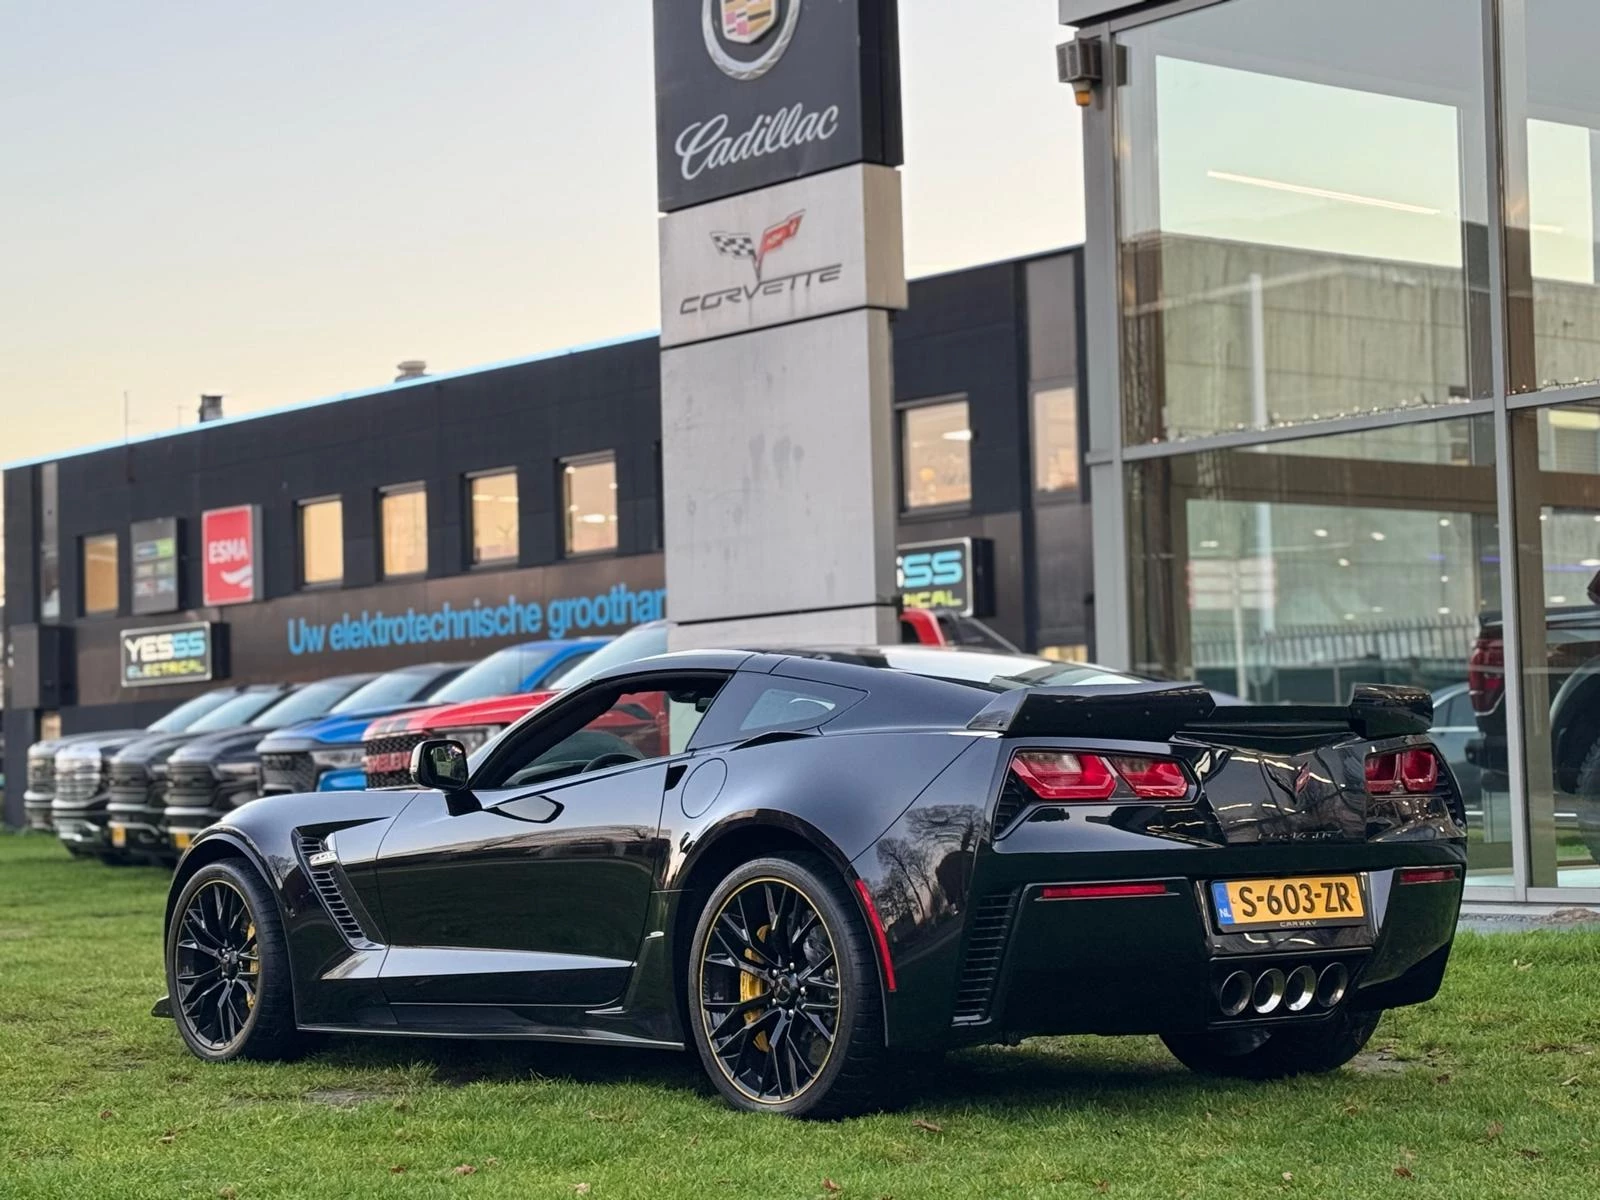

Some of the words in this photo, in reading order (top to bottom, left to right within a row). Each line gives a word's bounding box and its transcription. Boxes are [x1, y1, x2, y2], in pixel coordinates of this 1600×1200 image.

[674, 102, 839, 181] Cadillac
[679, 263, 842, 315] CORVETTE
[896, 550, 963, 588] SS
[287, 616, 325, 656] Uw
[329, 593, 543, 652] elektrotechnische
[124, 630, 207, 663] YESSS
[1218, 908, 1232, 919] NL
[1238, 881, 1355, 918] S-603-ZR
[1279, 920, 1318, 929] CARWAY
